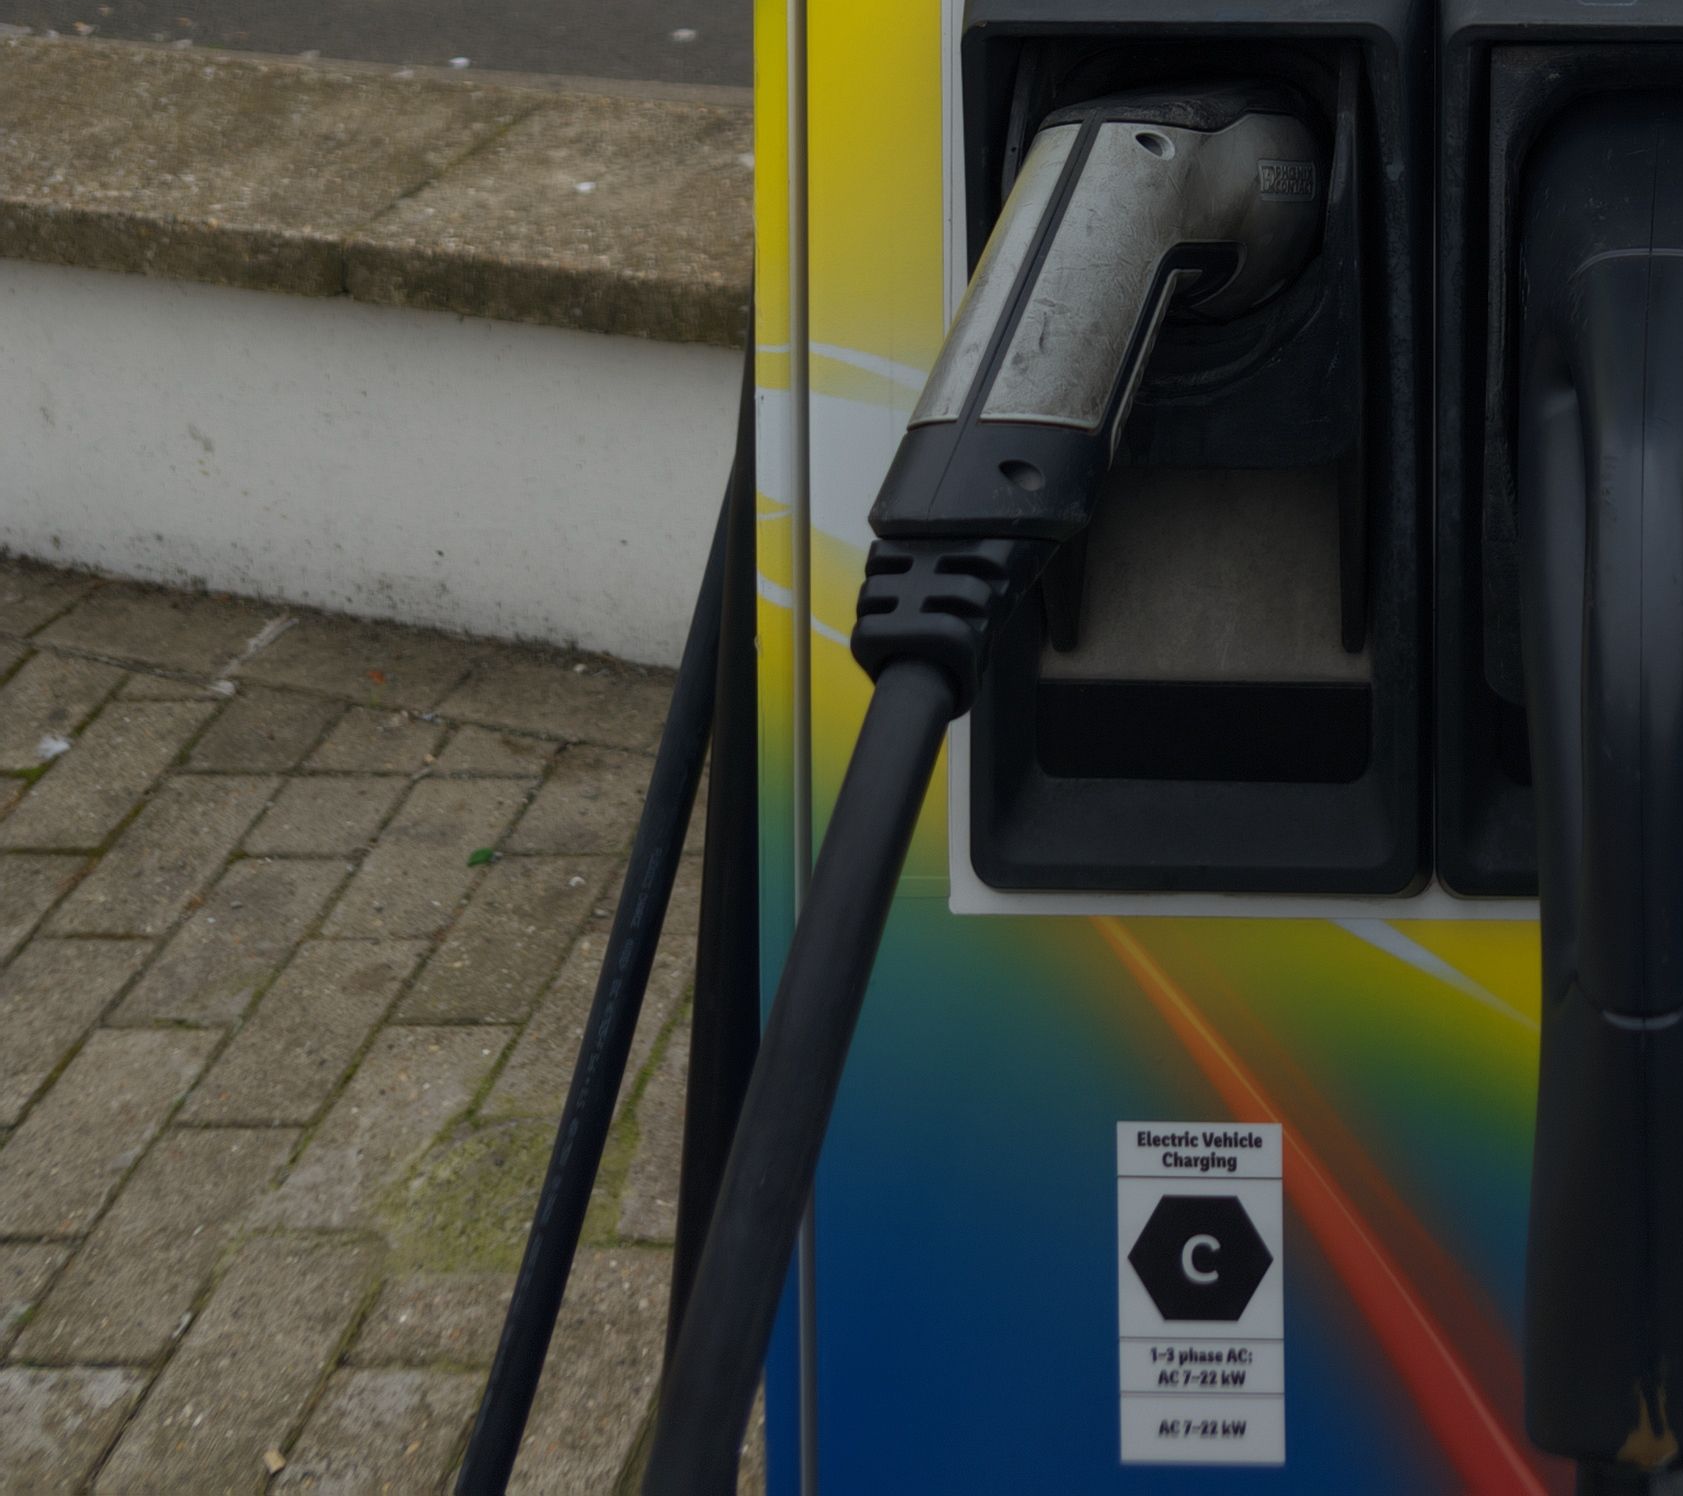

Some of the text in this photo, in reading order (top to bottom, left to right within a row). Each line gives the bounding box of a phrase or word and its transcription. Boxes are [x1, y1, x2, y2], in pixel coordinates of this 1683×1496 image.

[1136, 1130, 1263, 1150] Electric Vehicle
[1163, 1152, 1237, 1172] Charging
[1181, 1234, 1221, 1283] C
[1179, 1347, 1223, 1366] phase
[1158, 1370, 1178, 1387] AC
[1221, 1369, 1246, 1388] kW
[1159, 1419, 1179, 1436] AC
[1221, 1419, 1247, 1437] kW
